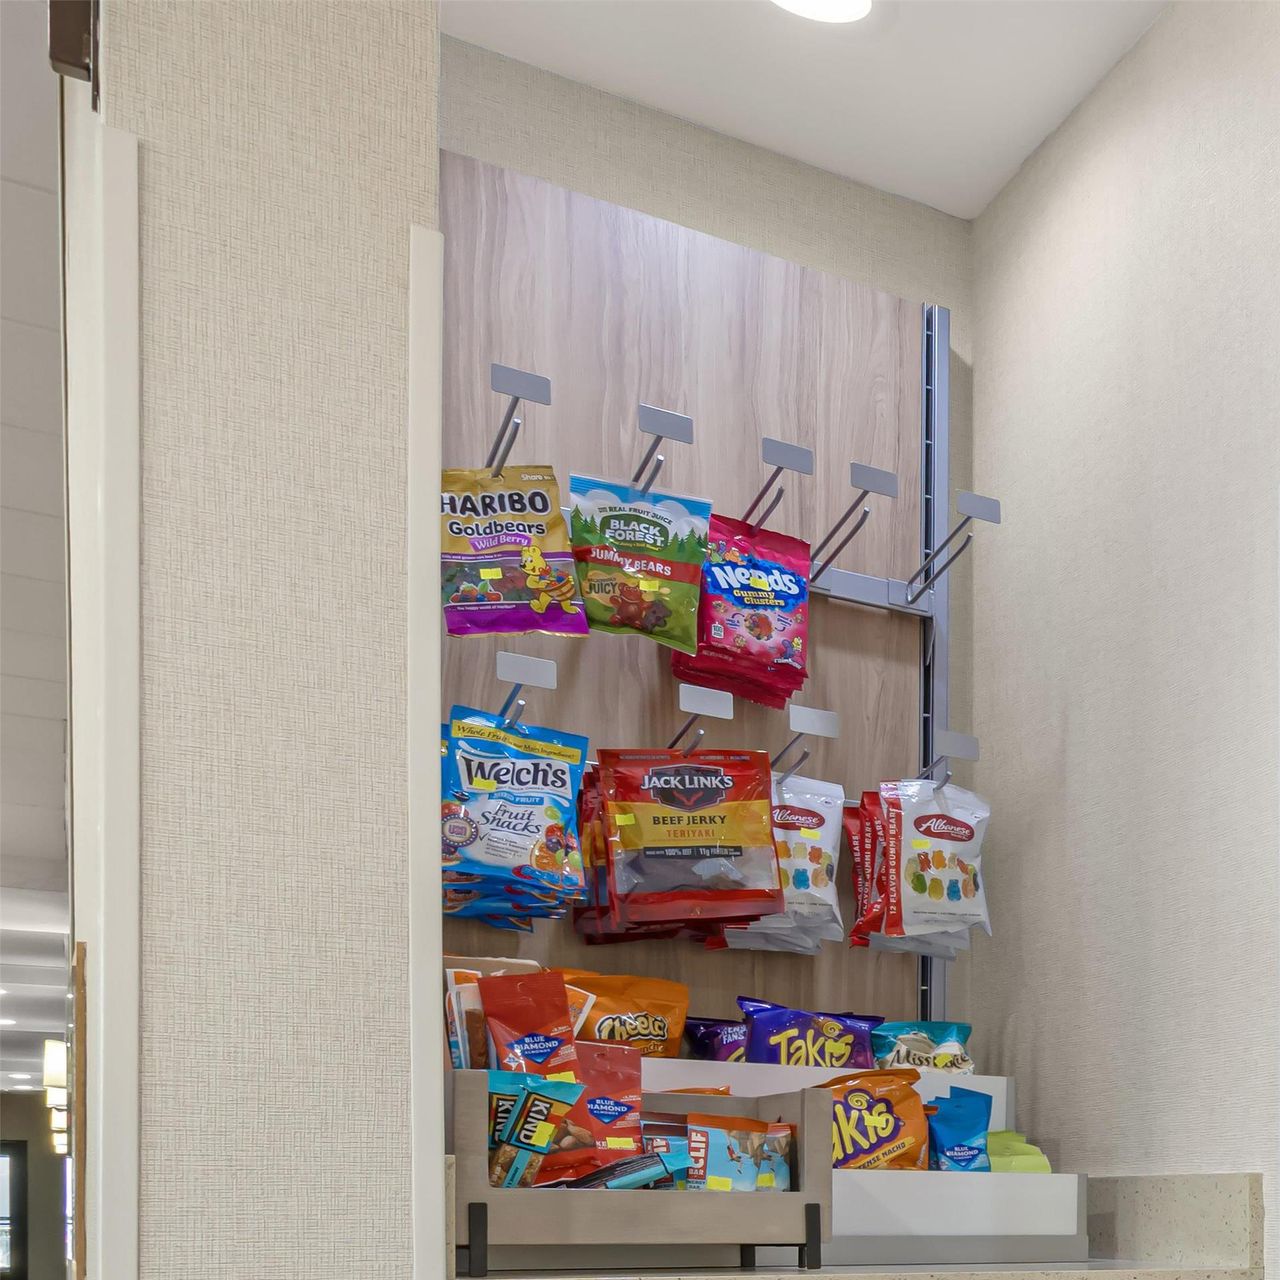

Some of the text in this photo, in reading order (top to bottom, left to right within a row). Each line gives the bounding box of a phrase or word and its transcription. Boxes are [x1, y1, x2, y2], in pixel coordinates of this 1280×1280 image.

[441, 491, 549, 516] HARIBO
[628, 507, 650, 517] FRUIT
[652, 512, 673, 525] JUICE
[449, 521, 546, 536] Goldbears
[610, 520, 661, 537] BLACK
[474, 534, 528, 549] Wild Berry
[605, 529, 665, 546] FOREST
[634, 559, 672, 576] BEARS
[587, 582, 618, 595] JUICY
[734, 590, 775, 600] Gummy
[744, 597, 785, 606] Clusters
[457, 725, 486, 737] Whole
[461, 756, 567, 788] Welch's
[641, 775, 733, 789] JACK LINK'S
[494, 804, 536, 821] Fruit
[652, 815, 727, 825] BEEF JERKY
[478, 811, 543, 834] Snacks
[921, 819, 972, 835] Albanese
[666, 829, 715, 837] TERIYAKI
[889, 837, 897, 866] GUMMI
[889, 868, 897, 902] FLAVOR
[889, 906, 897, 914] 12
[514, 1041, 559, 1050] DIAMOND
[769, 1029, 854, 1067] Takis
[495, 1100, 515, 1142] KIN
[519, 1100, 551, 1144] KIND
[691, 1132, 707, 1168] CLIF
